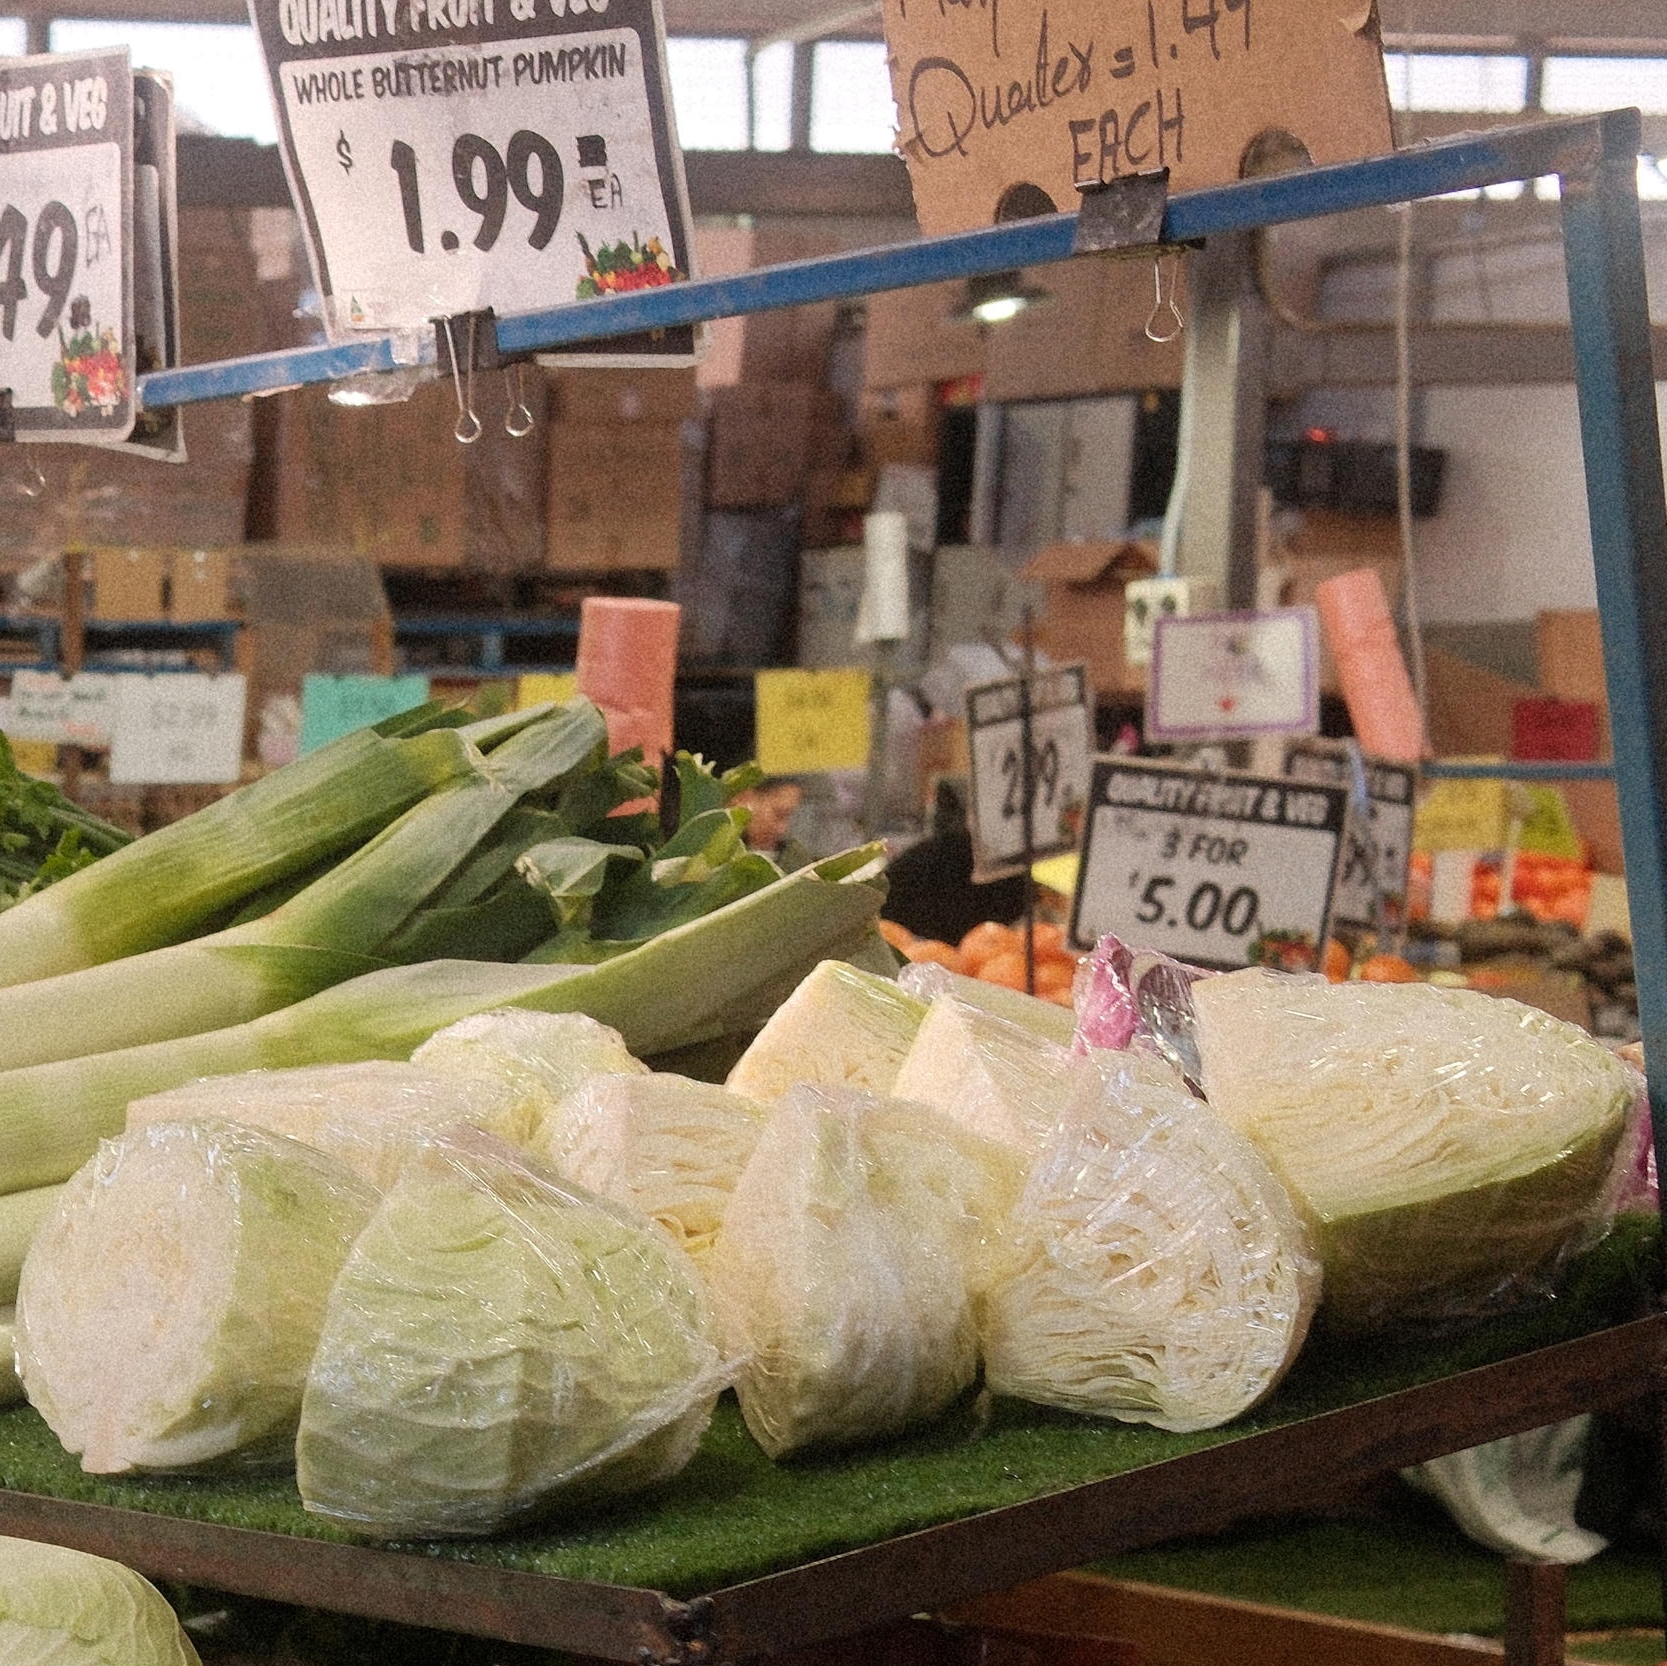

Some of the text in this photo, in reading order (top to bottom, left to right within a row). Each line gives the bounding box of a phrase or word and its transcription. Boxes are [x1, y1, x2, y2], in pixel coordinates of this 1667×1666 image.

[293, 43, 626, 104] WHOLE BUTTERNUT PUMPKIN
[40, 83, 58, 136] &
[63, 76, 108, 134] VEG
[1069, 88, 1186, 184] EACH
[1188, 833, 1248, 865] FOR
